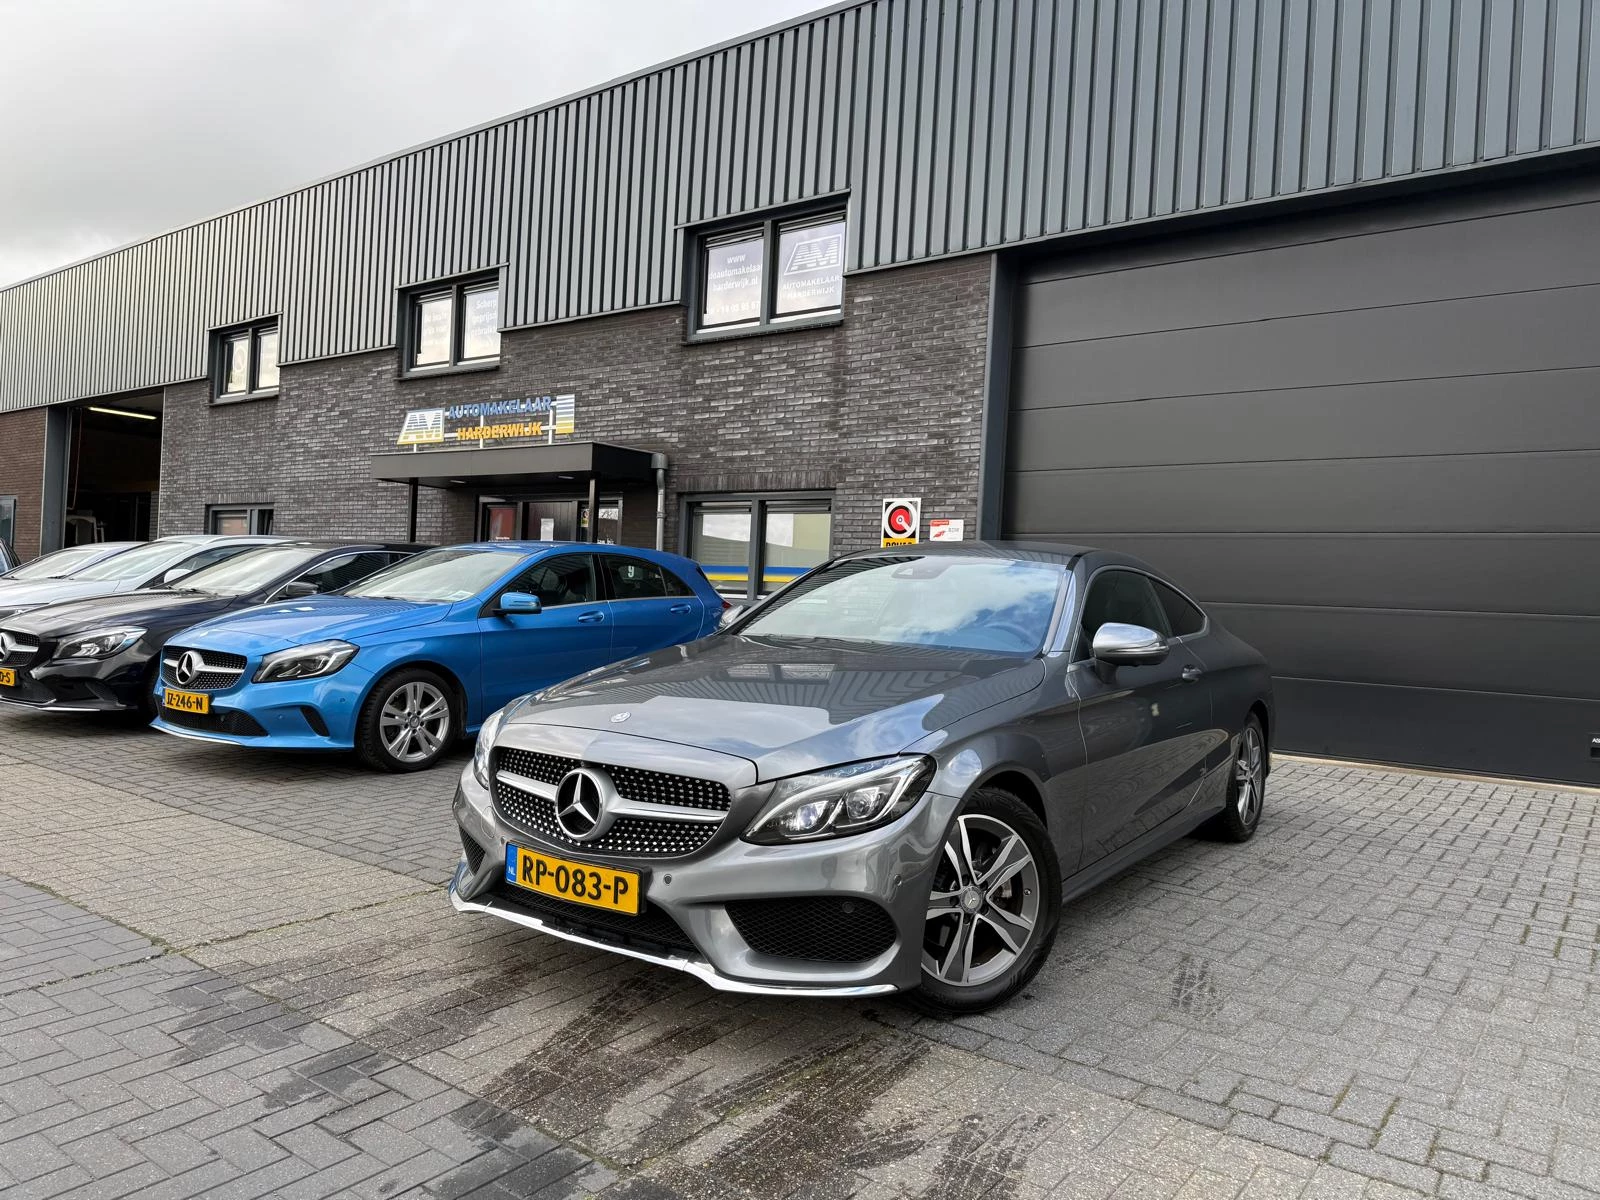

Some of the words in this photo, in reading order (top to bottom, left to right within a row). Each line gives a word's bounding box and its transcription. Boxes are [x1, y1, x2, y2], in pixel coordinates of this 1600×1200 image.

[447, 396, 552, 419] AUTOMAKELAAR
[456, 421, 543, 441] HARDERWIJK
[627, 565, 635, 578] 9
[166, 692, 203, 711] JZ-246-N
[522, 854, 629, 905] RP-083-P
